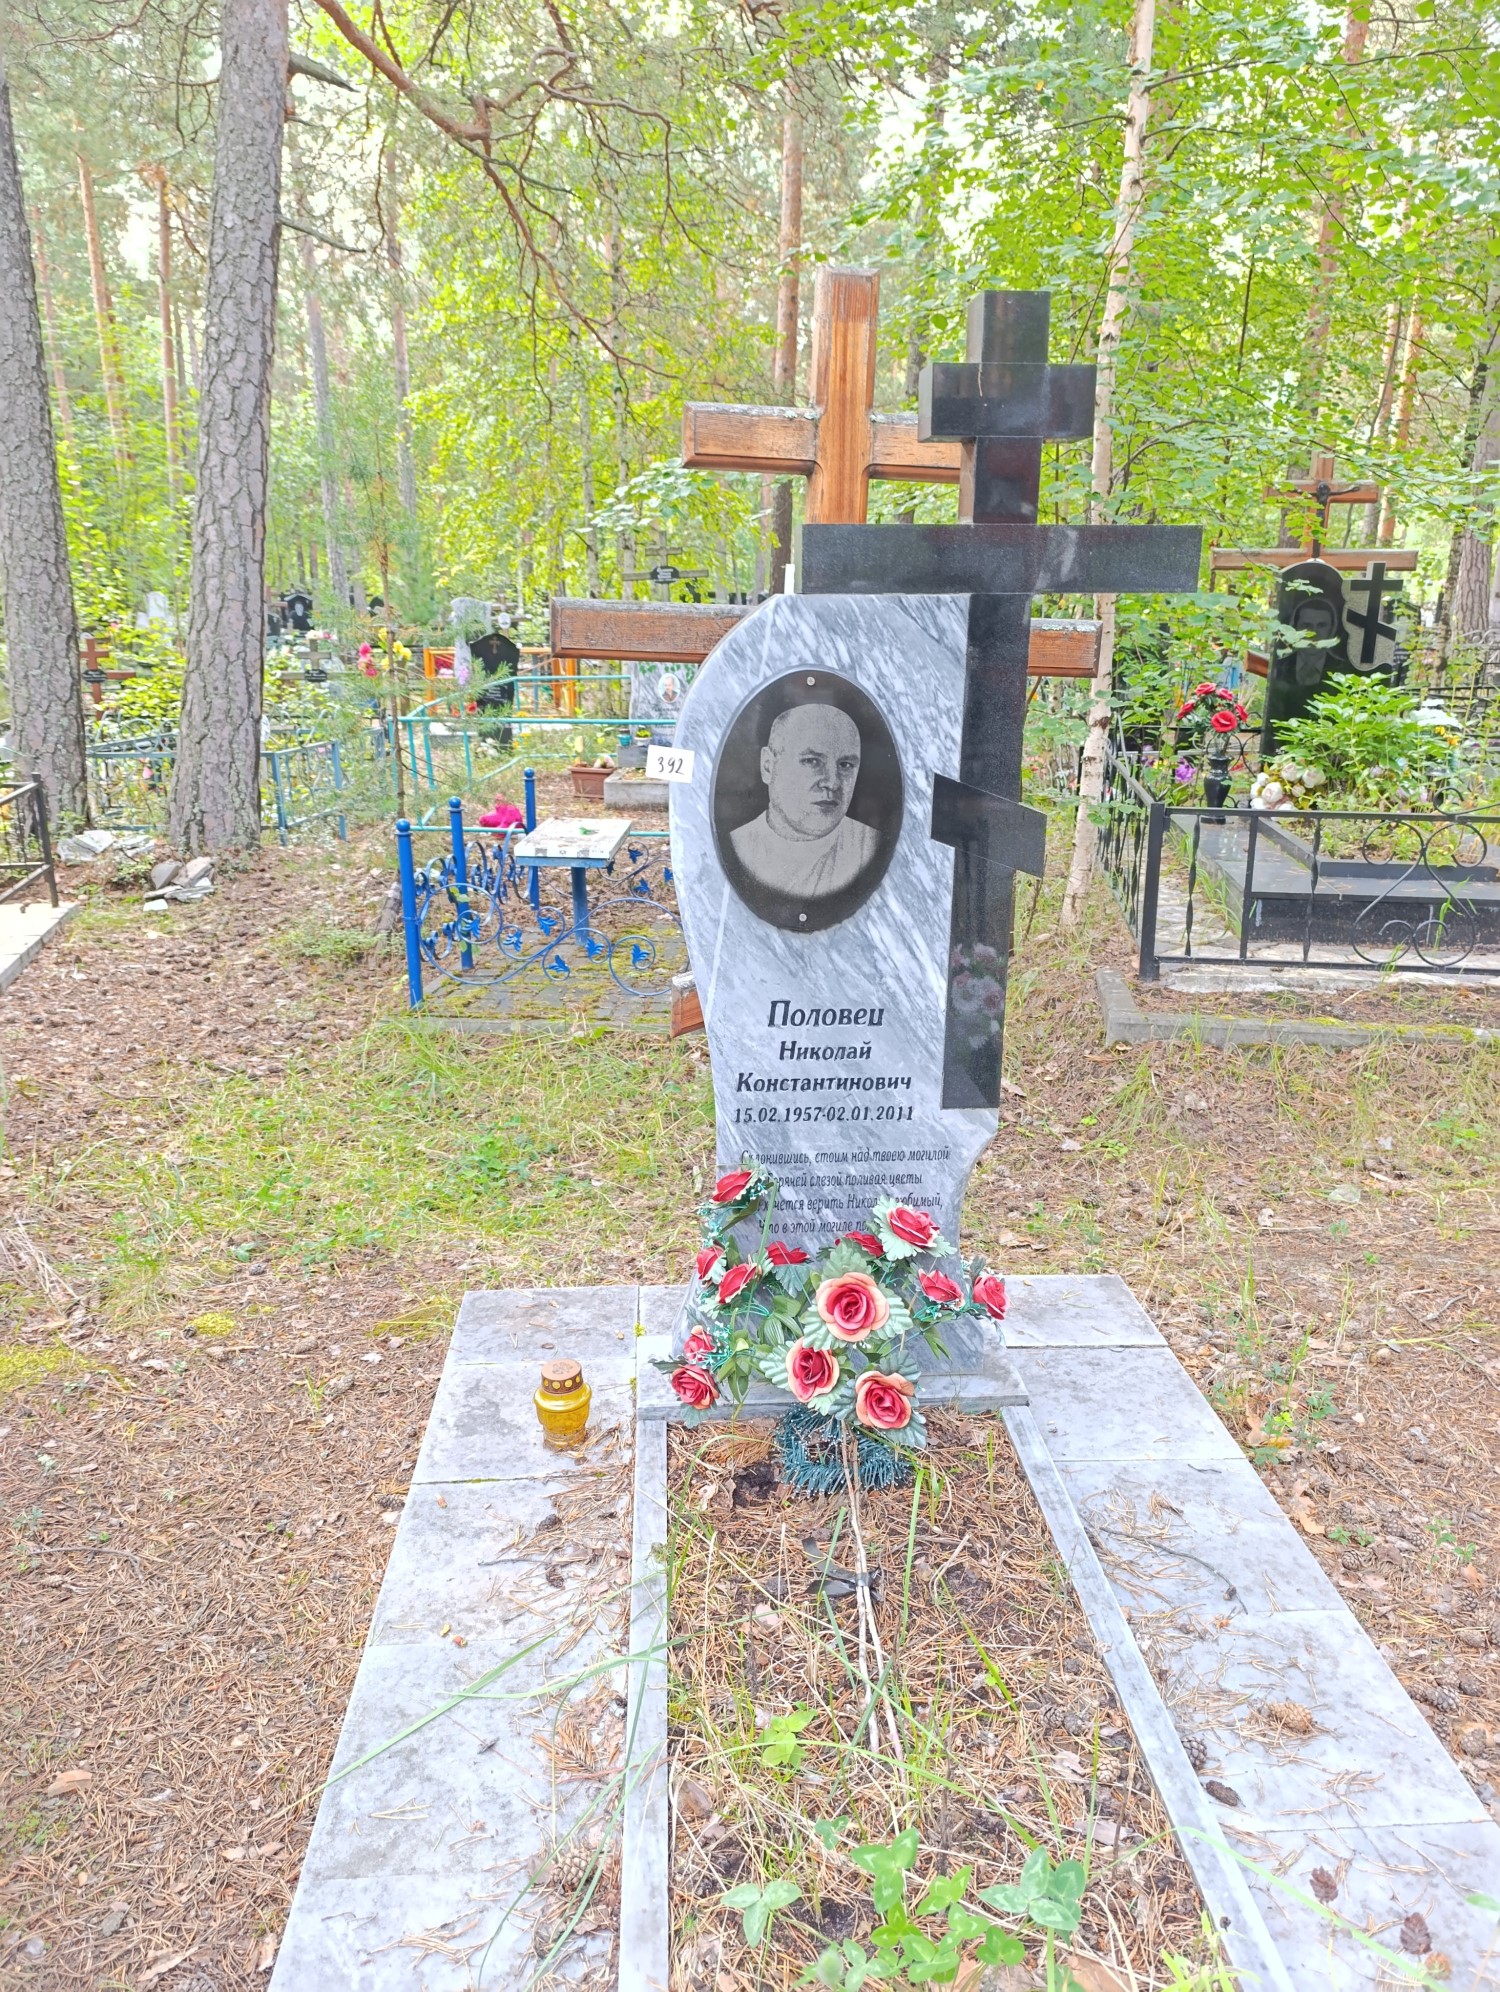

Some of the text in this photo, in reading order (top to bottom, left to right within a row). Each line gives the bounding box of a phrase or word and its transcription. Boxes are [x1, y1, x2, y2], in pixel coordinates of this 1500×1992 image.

[657, 756, 685, 775] 392
[767, 1000, 885, 1027] Половец
[778, 1040, 873, 1061] Николай
[736, 1072, 912, 1092] Константинович
[735, 1106, 914, 1123] 15.02.1957-02.01.2011
[815, 1151, 848, 1163] стоим
[851, 1147, 870, 1162] над
[873, 1150, 905, 1162] твоею
[907, 1146, 950, 1161] могилой
[845, 1173, 888, 1187] поливая
[889, 1173, 923, 1187] цветы
[807, 1198, 844, 1214] верить
[782, 1223, 789, 1234] в
[790, 1219, 815, 1233] этой
[818, 1221, 852, 1233] могиле
